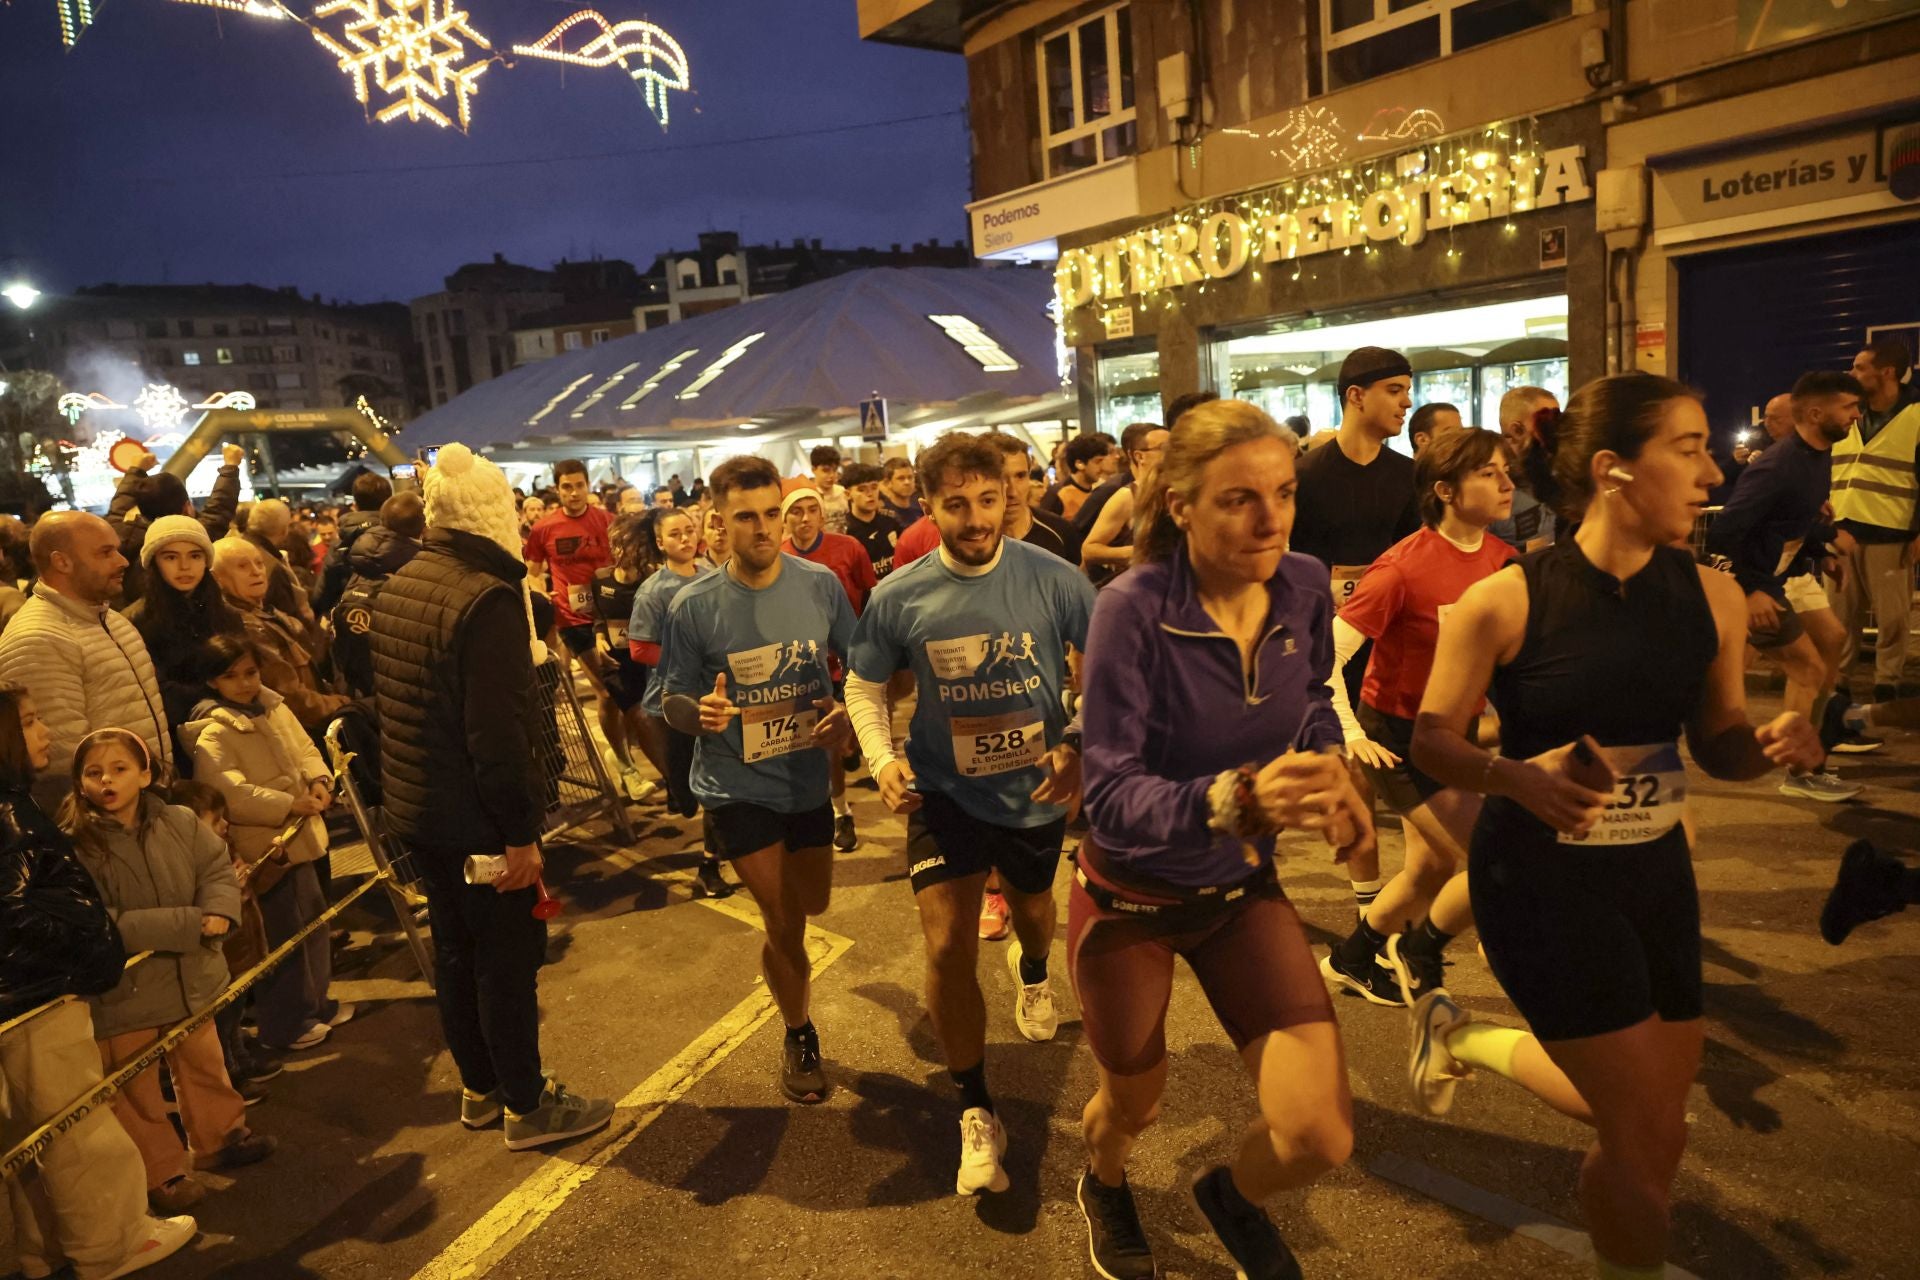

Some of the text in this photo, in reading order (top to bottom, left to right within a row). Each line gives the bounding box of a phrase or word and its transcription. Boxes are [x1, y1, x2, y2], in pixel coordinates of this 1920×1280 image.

[1703, 154, 1868, 203] Loterías y
[983, 203, 1040, 230] Podemos
[984, 231, 1013, 248] Siero
[735, 678, 821, 704] PDMSiero
[938, 675, 1041, 703] PDMSiero
[762, 714, 799, 739] 174
[975, 729, 1025, 755] 528
[972, 756, 982, 765] EL
[1605, 775, 1660, 810] 32
[1601, 811, 1652, 825] MARINA
[1111, 898, 1161, 912] GORE-TEX
